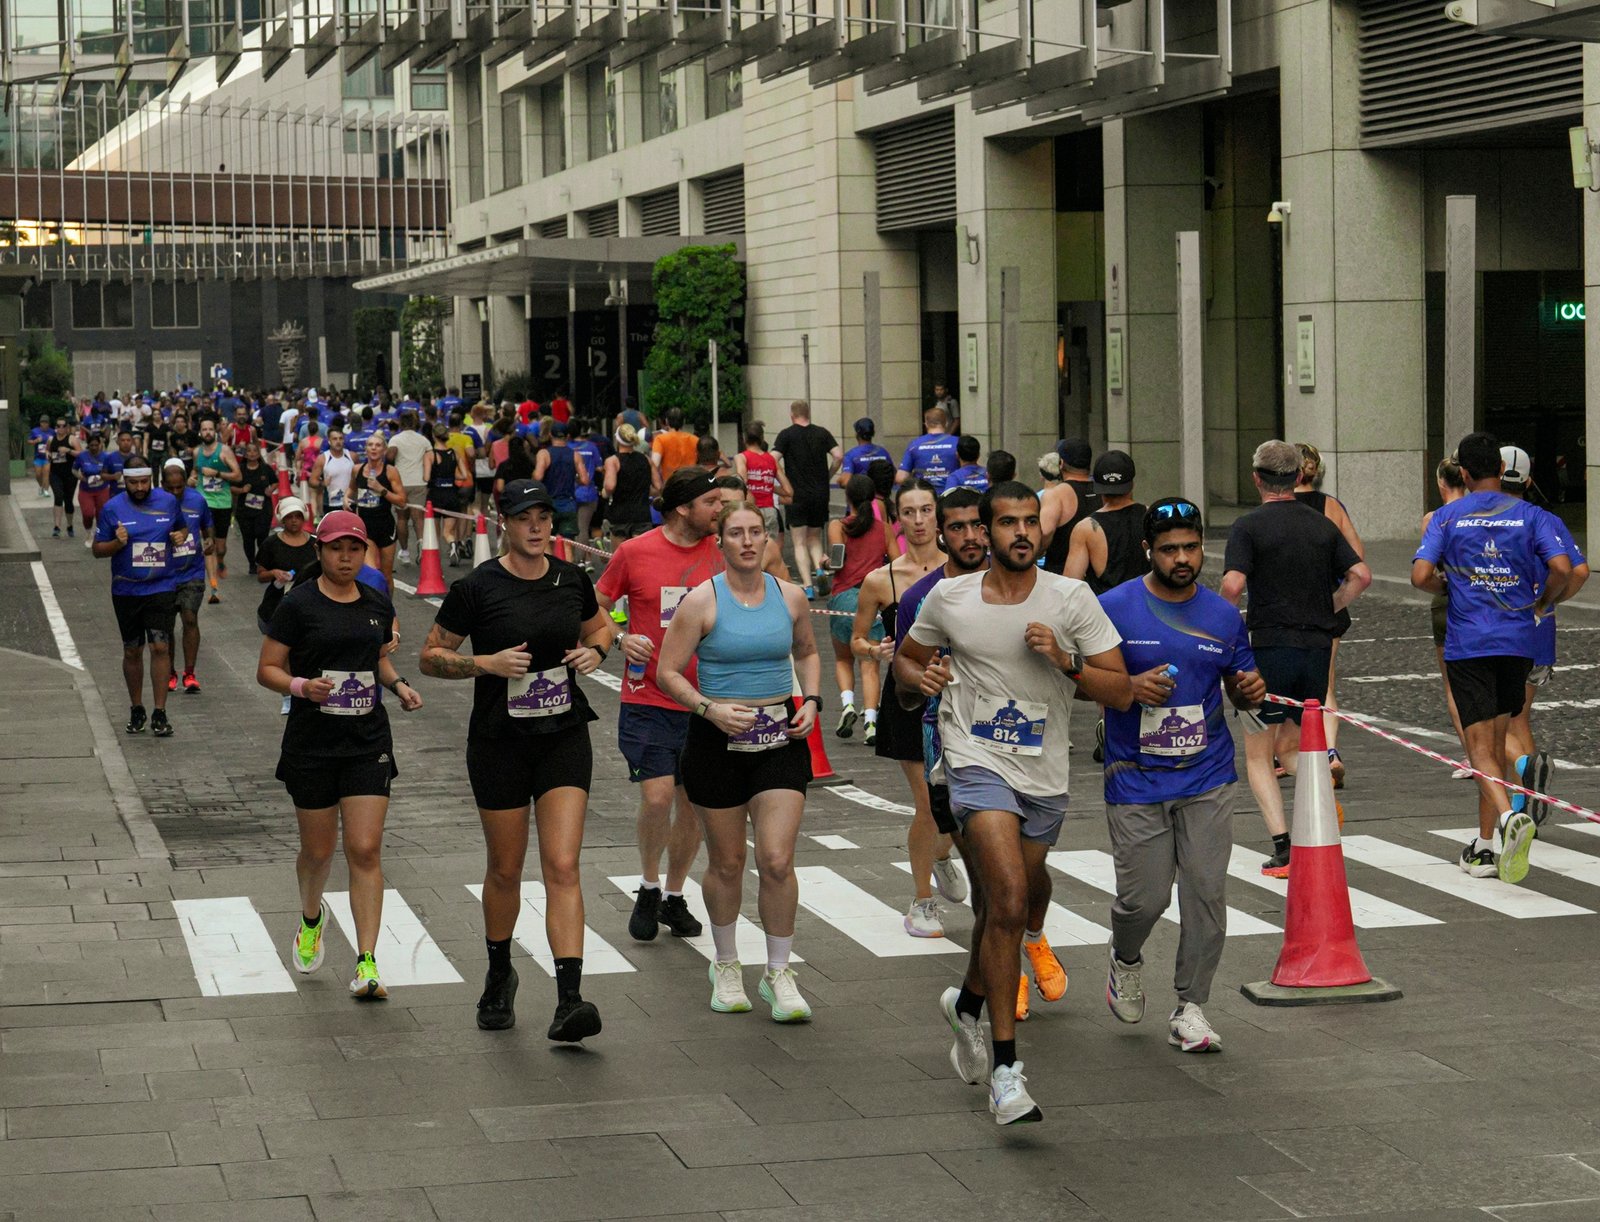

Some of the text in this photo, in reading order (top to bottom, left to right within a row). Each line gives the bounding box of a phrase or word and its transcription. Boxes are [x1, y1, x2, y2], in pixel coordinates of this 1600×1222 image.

[140, 252, 254, 269] CURRENCY
[590, 336, 606, 346] GO
[630, 332, 649, 342] The
[544, 341, 560, 350] GO
[544, 354, 561, 379] 2
[592, 350, 608, 377] 2
[1455, 518, 1525, 528] SKECHERS
[1474, 564, 1511, 574] Plus500
[1470, 580, 1520, 588] MARATHON
[350, 697, 372, 708] 1013
[538, 693, 568, 708] 1407
[757, 731, 787, 744] 1064
[993, 727, 1020, 743] 814
[1170, 734, 1203, 747] 1047
